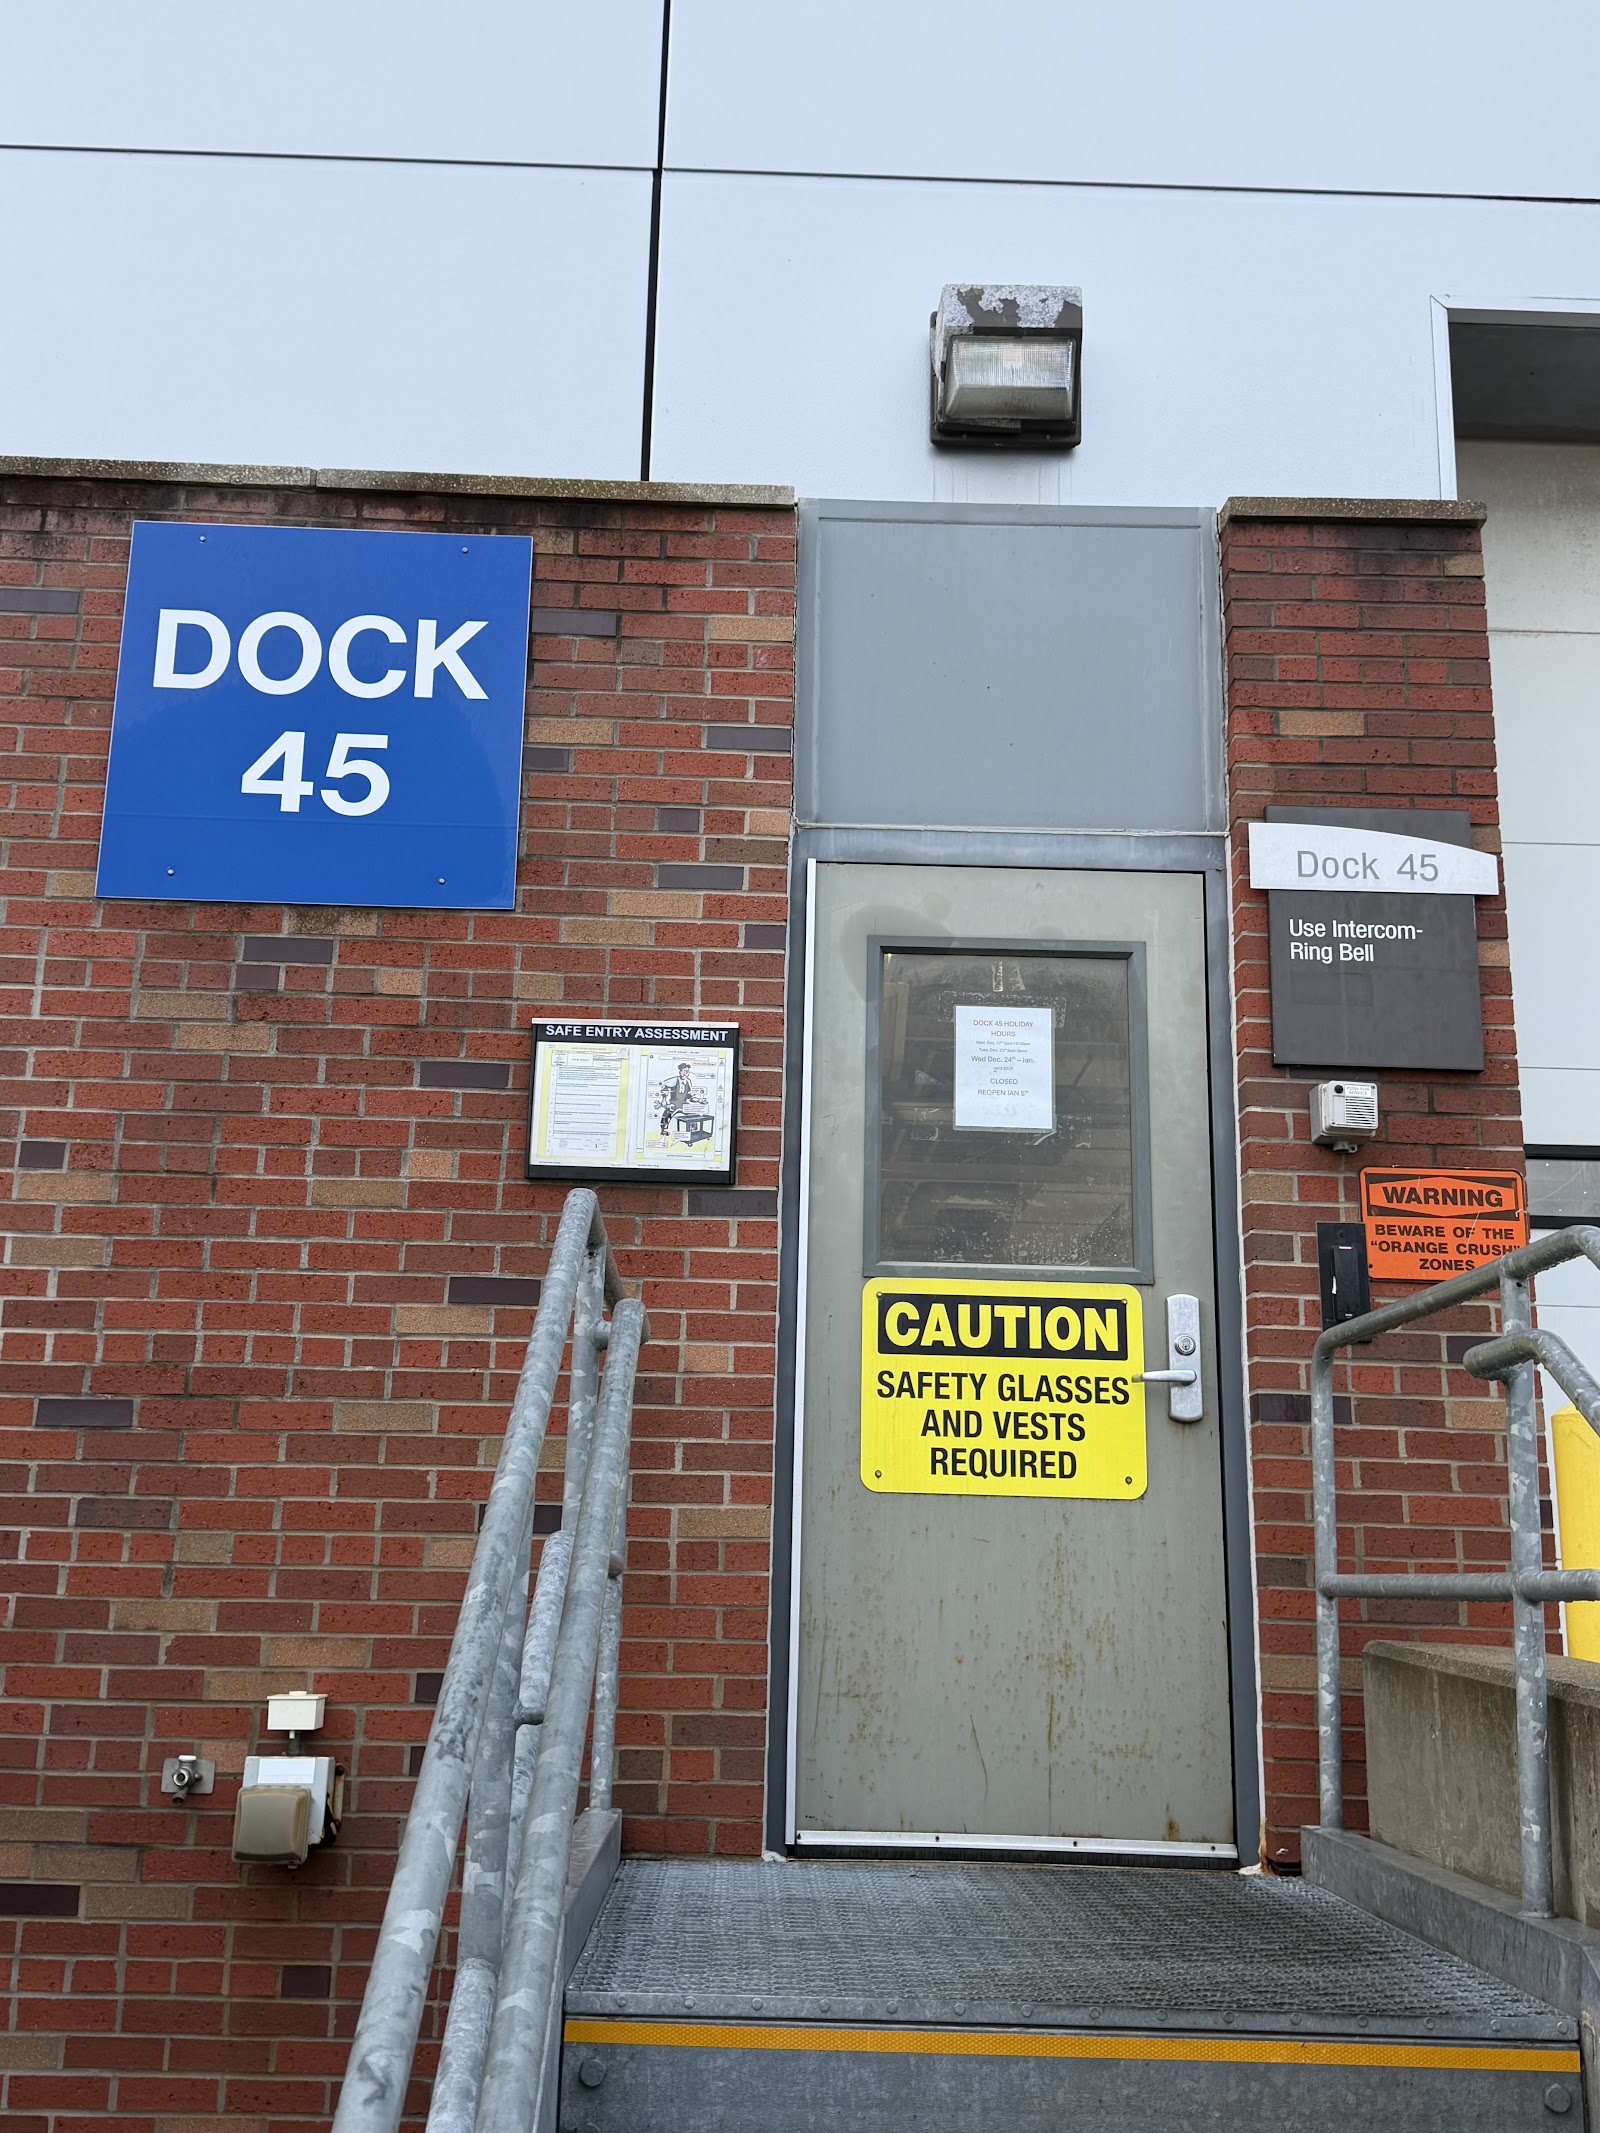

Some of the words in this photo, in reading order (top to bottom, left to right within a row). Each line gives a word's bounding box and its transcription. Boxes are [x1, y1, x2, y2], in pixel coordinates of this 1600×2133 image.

[153, 609, 489, 699] DOCK
[240, 731, 391, 817] 45
[1297, 850, 1380, 880] Dock
[1396, 853, 1439, 882] 45
[1289, 919, 1326, 937] Use
[1333, 920, 1423, 940] Intercom-
[1290, 942, 1332, 965] Ring
[1340, 944, 1374, 962] Bell
[546, 1025, 582, 1037] SAFE
[586, 1027, 631, 1039] ENTRY
[635, 1028, 728, 1041] ASSESSMENT
[1382, 1186, 1503, 1208] WARNING
[1375, 1224, 1446, 1238] BEWARE
[1453, 1226, 1476, 1239] OF
[1482, 1228, 1514, 1240] THE
[1370, 1240, 1449, 1255] "ORANGE
[1419, 1258, 1475, 1271] ZONES
[884, 1301, 1118, 1352] CAUTION
[877, 1370, 987, 1401] SAFETY
[998, 1373, 1129, 1405] GLASSES
[921, 1409, 982, 1438] AND
[993, 1411, 1086, 1442] VESTS
[930, 1447, 1077, 1479] REQUIRED
